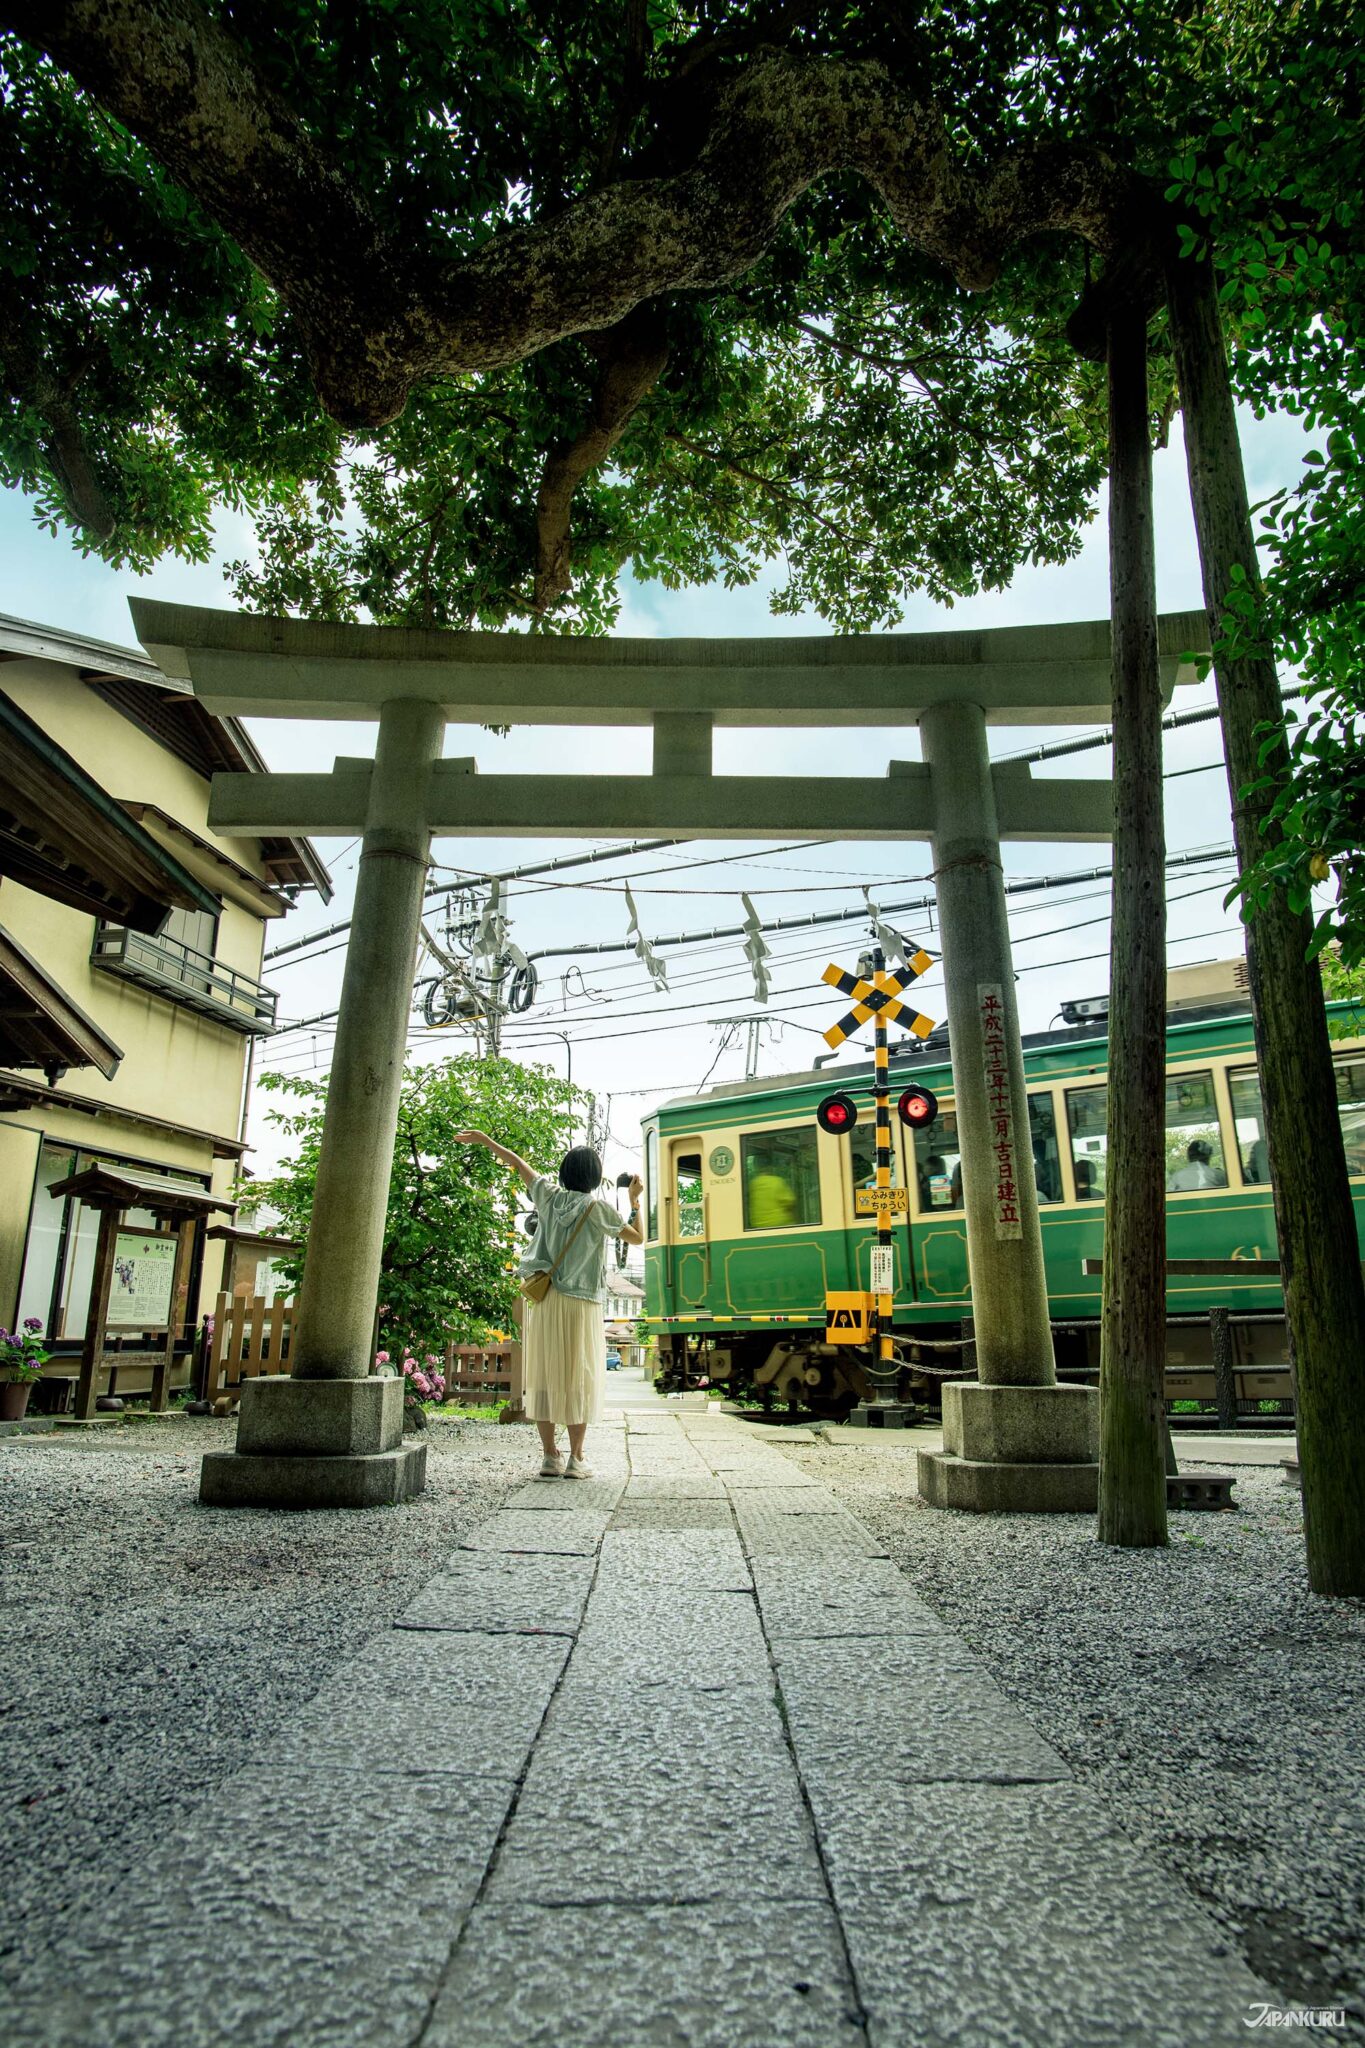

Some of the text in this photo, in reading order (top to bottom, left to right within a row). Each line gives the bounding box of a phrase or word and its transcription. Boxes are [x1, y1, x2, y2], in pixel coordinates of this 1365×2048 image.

[980, 995, 1019, 1223] 平成二十三年十二月吉日建立
[871, 1190, 905, 1200] ふみきり
[871, 1200, 906, 1210] ちゅうい
